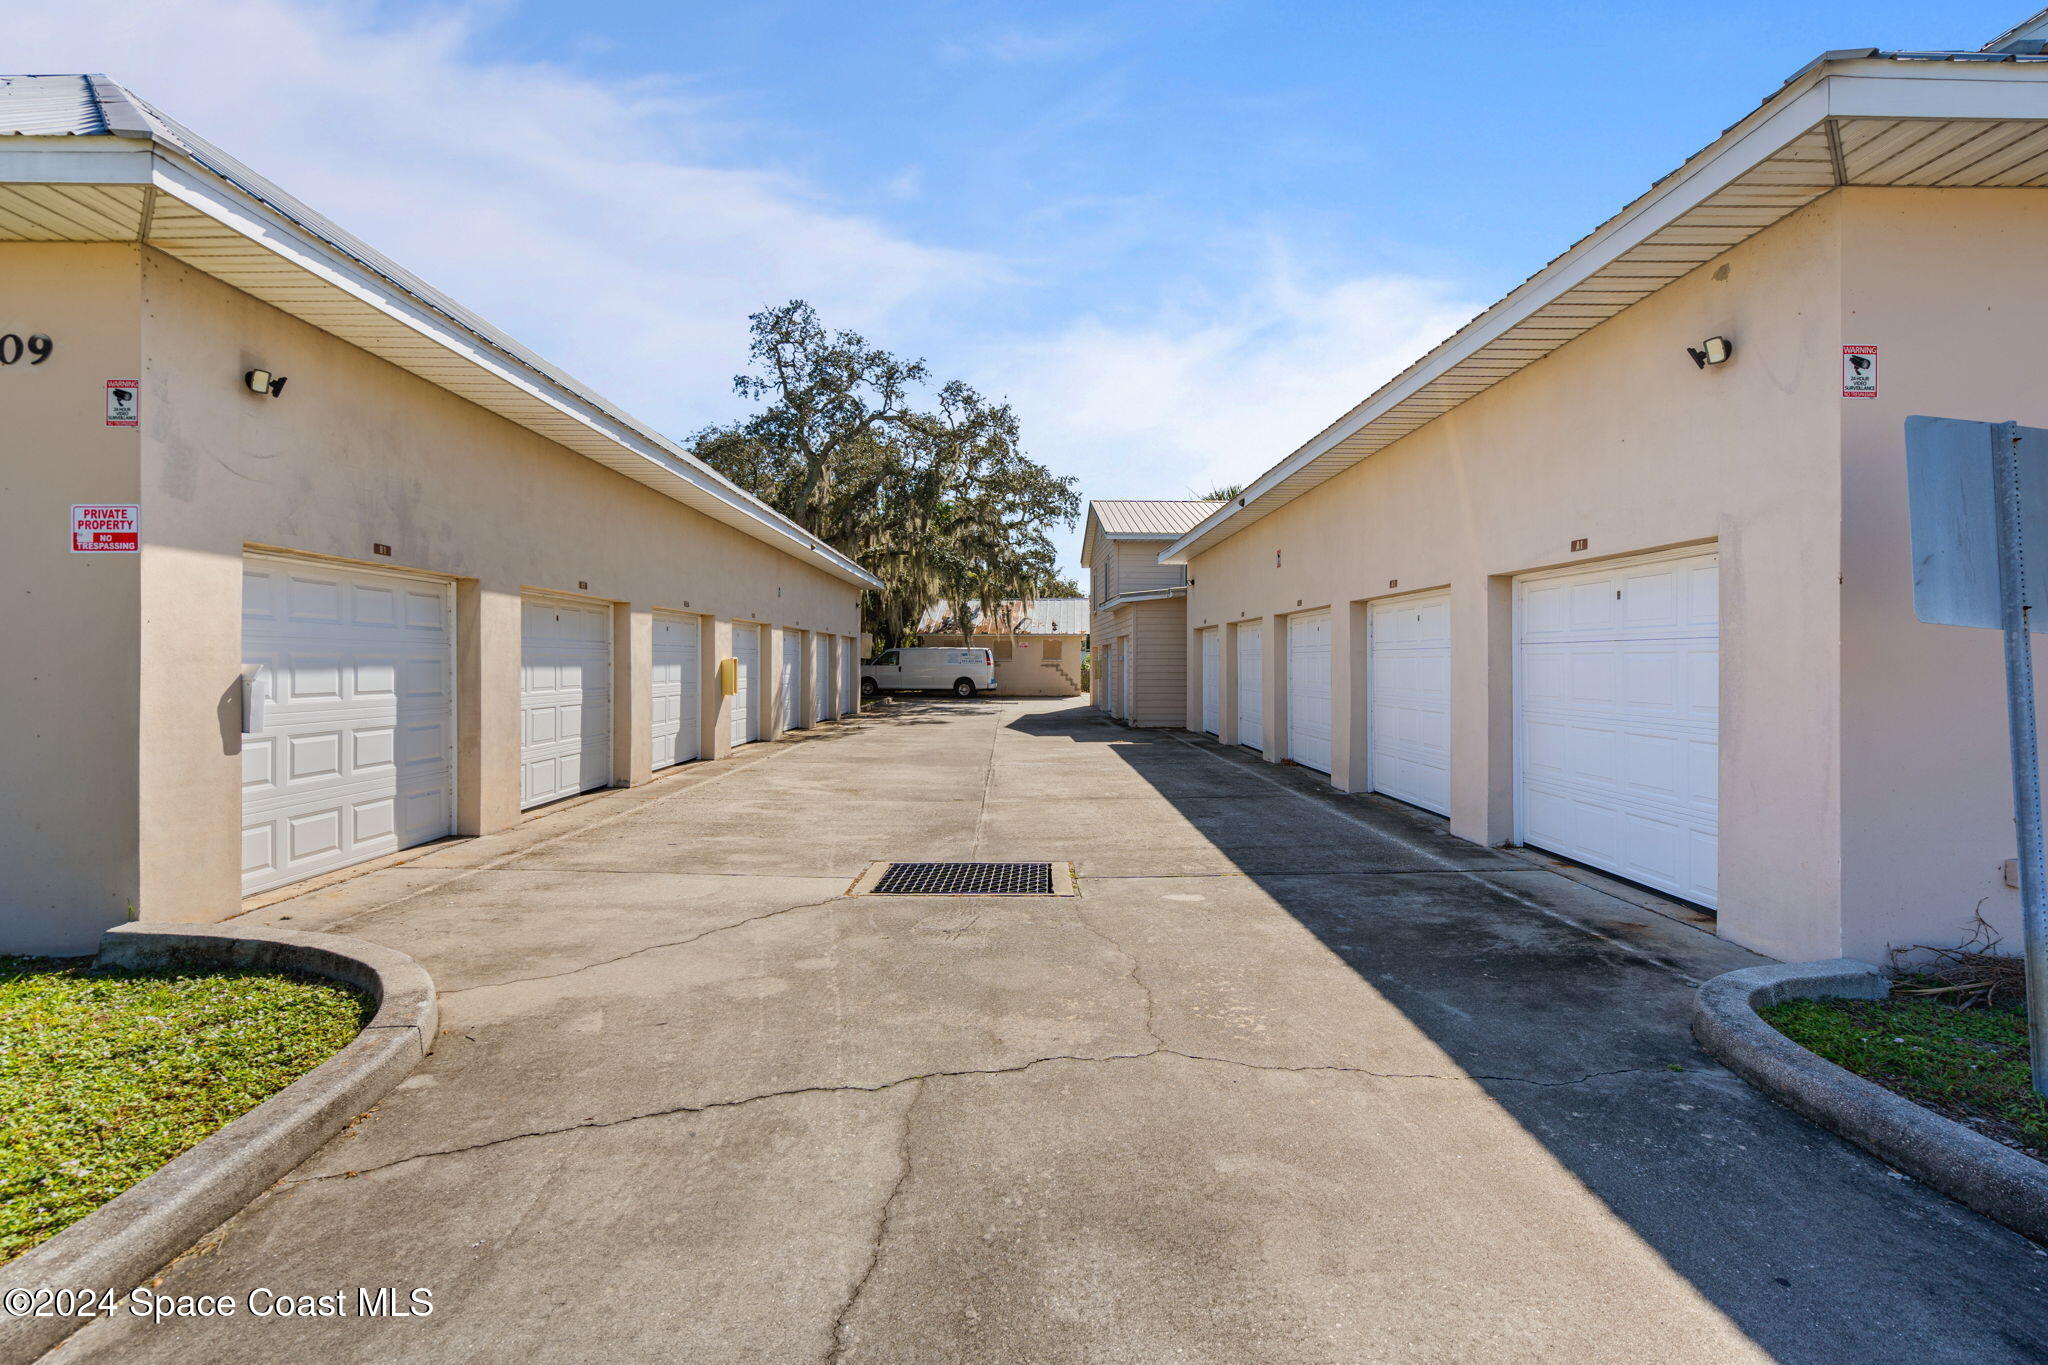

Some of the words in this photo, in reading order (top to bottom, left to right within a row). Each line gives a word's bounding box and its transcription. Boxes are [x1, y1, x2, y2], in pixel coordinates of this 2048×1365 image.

[0, 334, 53, 365] 09
[84, 509, 128, 519] PRIVATE
[78, 520, 133, 530] PROPERTY
